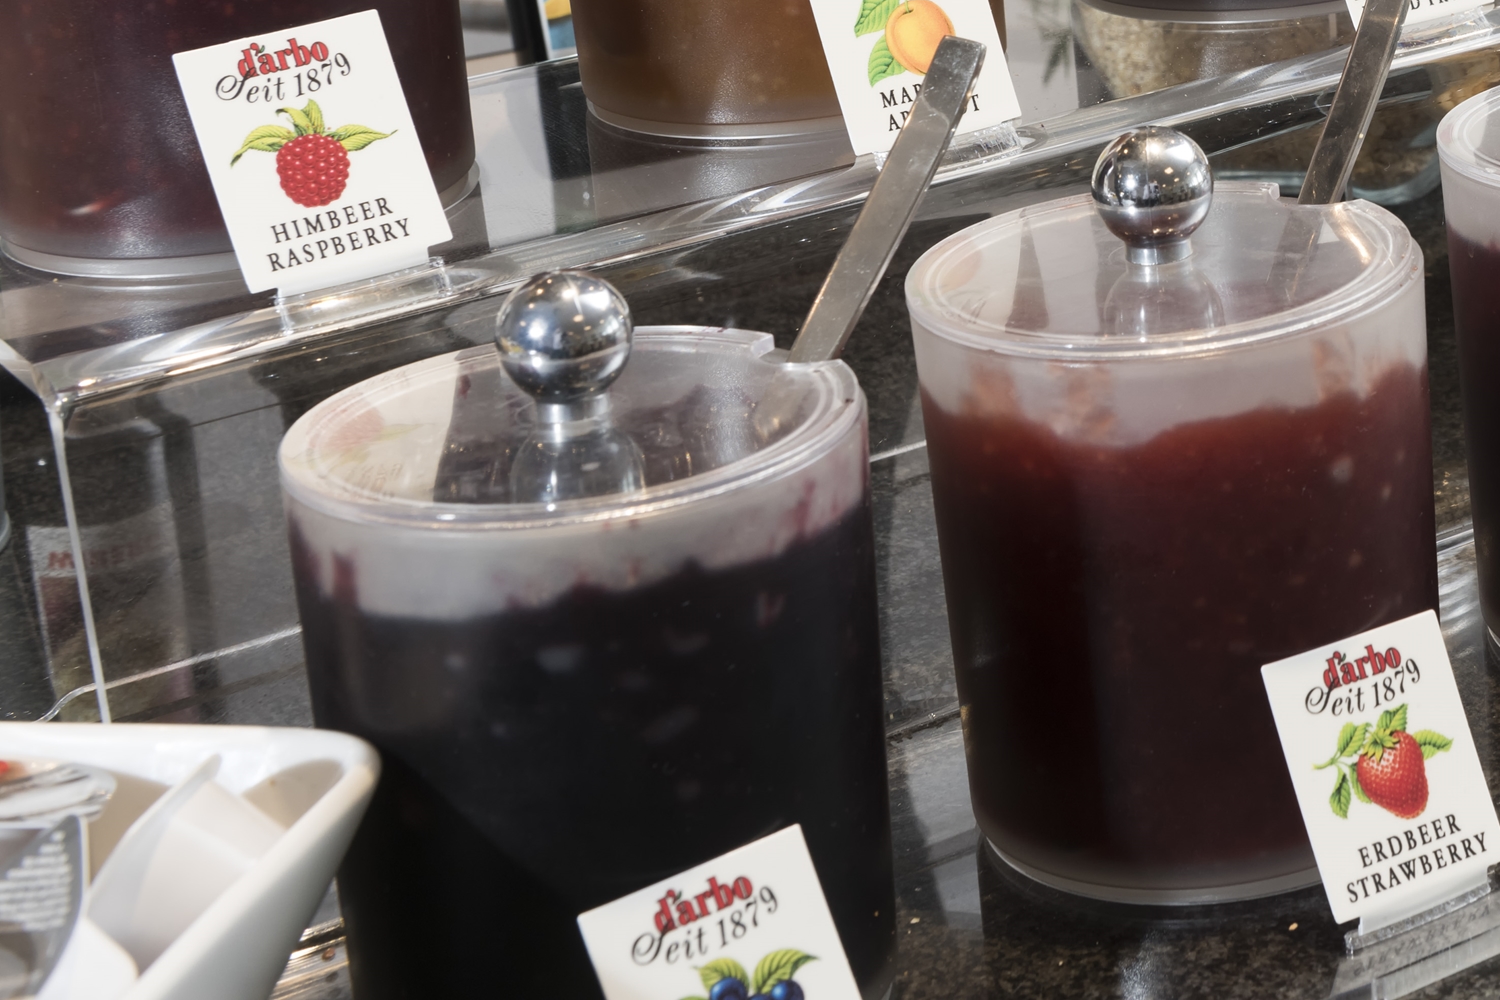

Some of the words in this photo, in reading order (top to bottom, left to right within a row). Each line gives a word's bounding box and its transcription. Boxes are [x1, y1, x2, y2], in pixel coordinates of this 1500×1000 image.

[215, 68, 285, 103] Seit
[294, 52, 351, 98] 1879
[267, 218, 411, 272] RASPBERRY
[270, 197, 393, 243] HIMBEER
[1305, 678, 1365, 716] Seit
[1372, 658, 1421, 709] 1879
[1346, 831, 1487, 903] STRAWBERRY
[1358, 813, 1461, 868] ERDBEER
[631, 921, 708, 966] Seit
[716, 885, 779, 949] 1879
